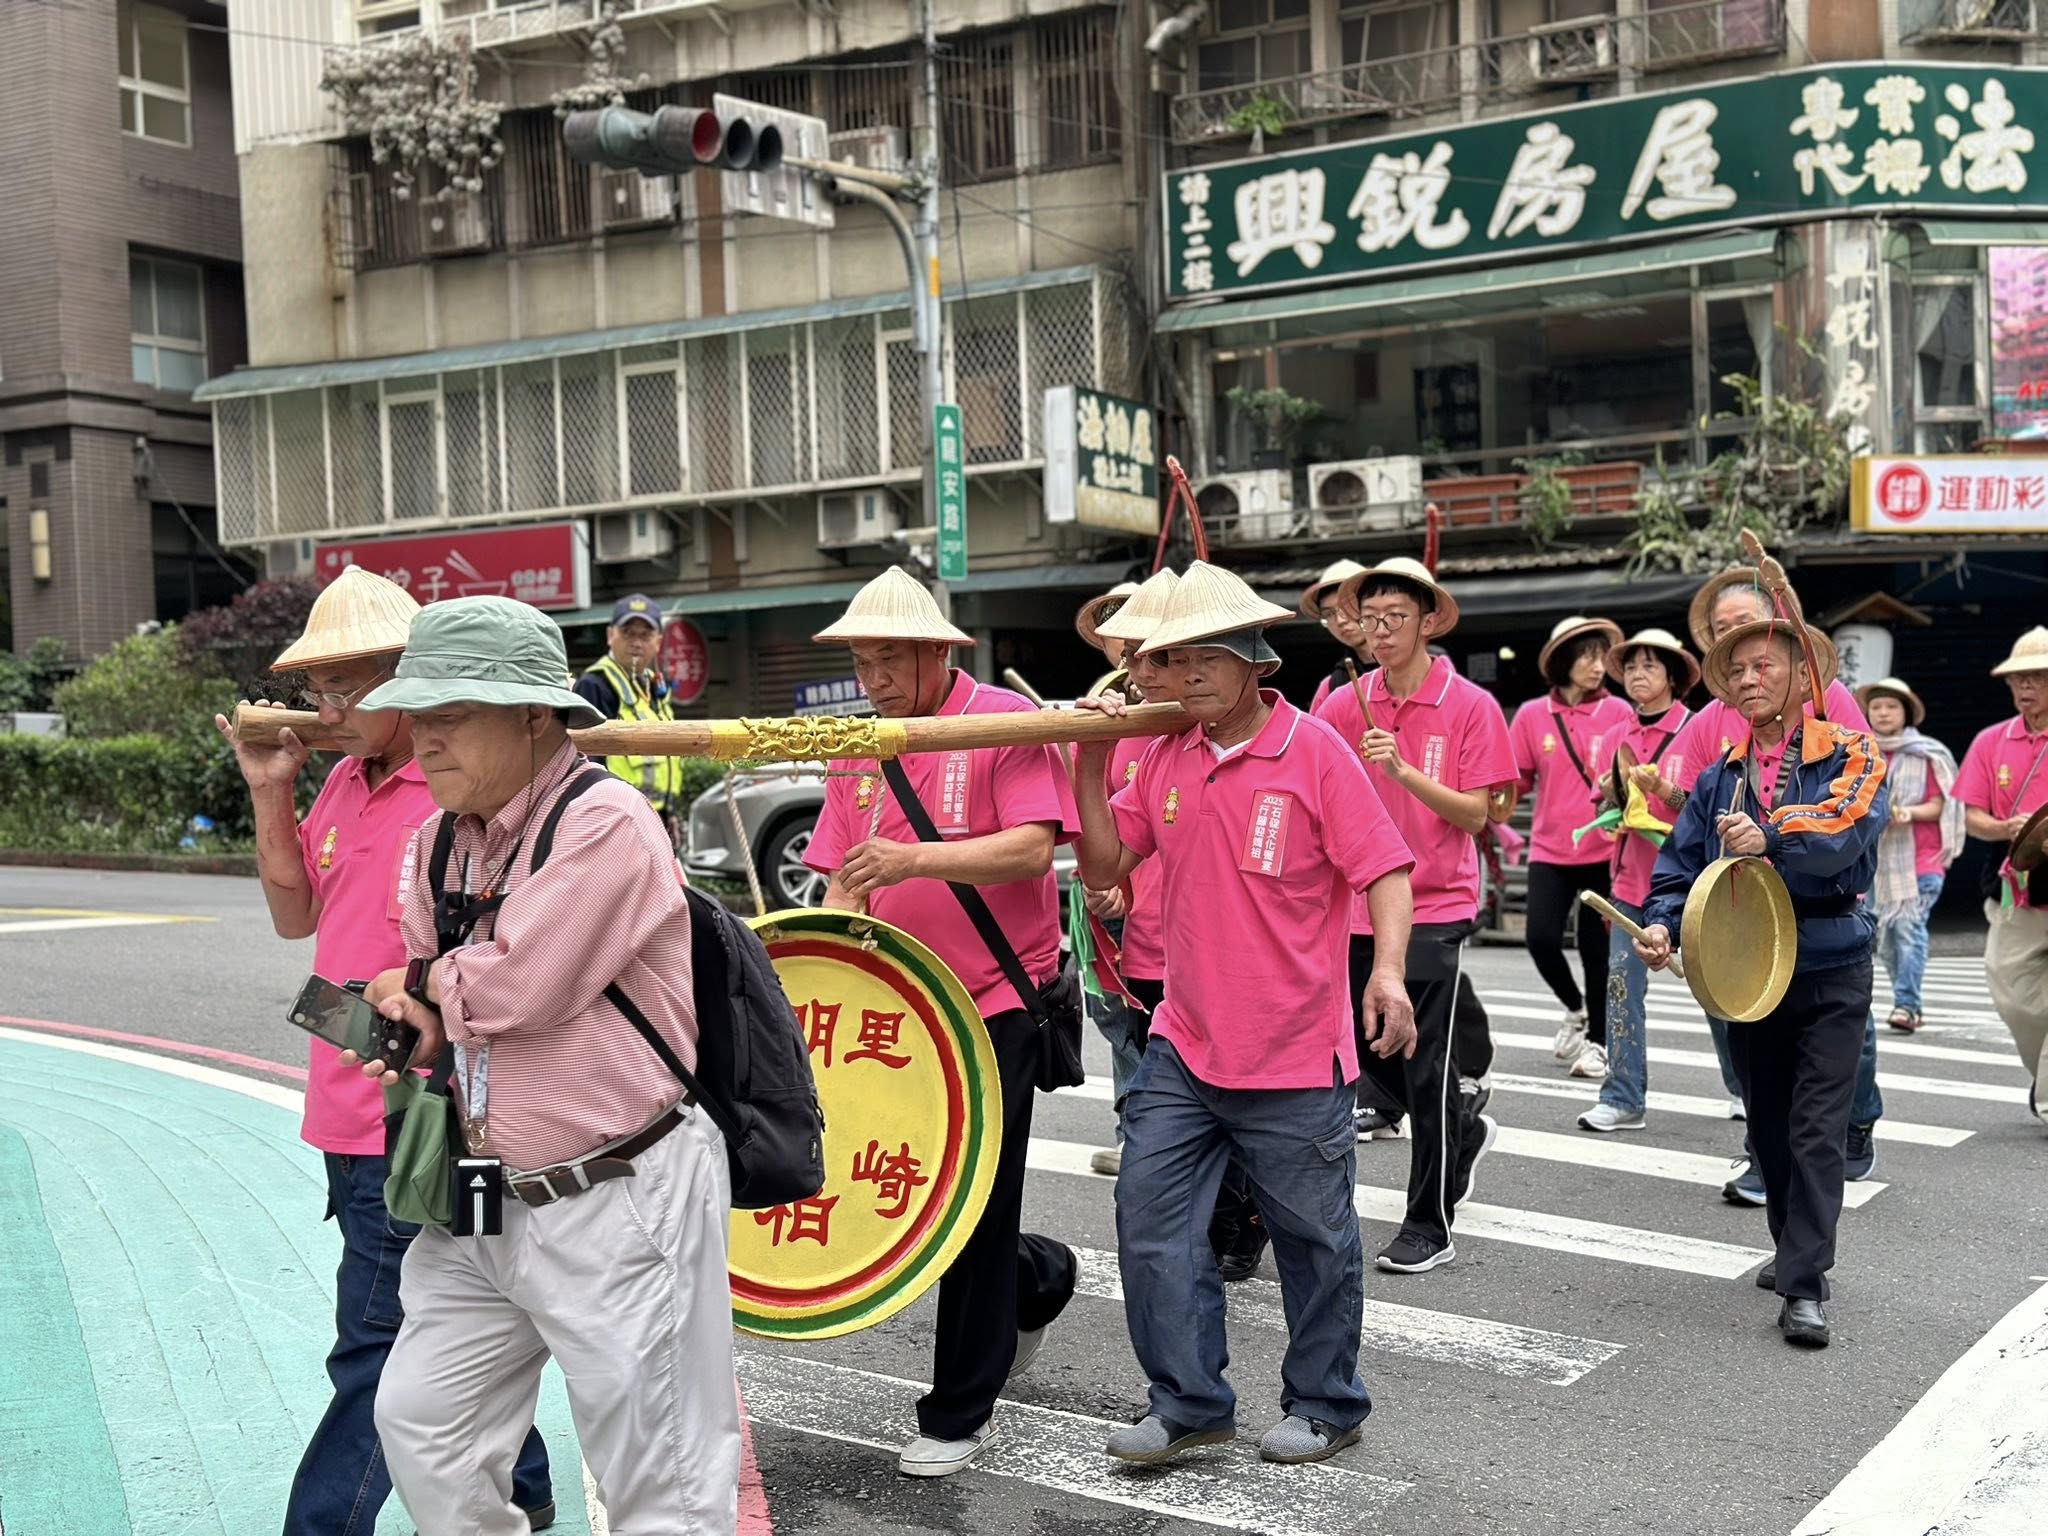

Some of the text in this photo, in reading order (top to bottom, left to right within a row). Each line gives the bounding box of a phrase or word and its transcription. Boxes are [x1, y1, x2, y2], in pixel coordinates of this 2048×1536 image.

[1935, 78, 2035, 194] 法
[1226, 99, 1737, 278] 興銳房屋
[1178, 172, 1215, 292] 請上二樓
[1937, 475, 2046, 512] 運動彩
[949, 752, 968, 760] 2025
[1263, 795, 1284, 806] 2025
